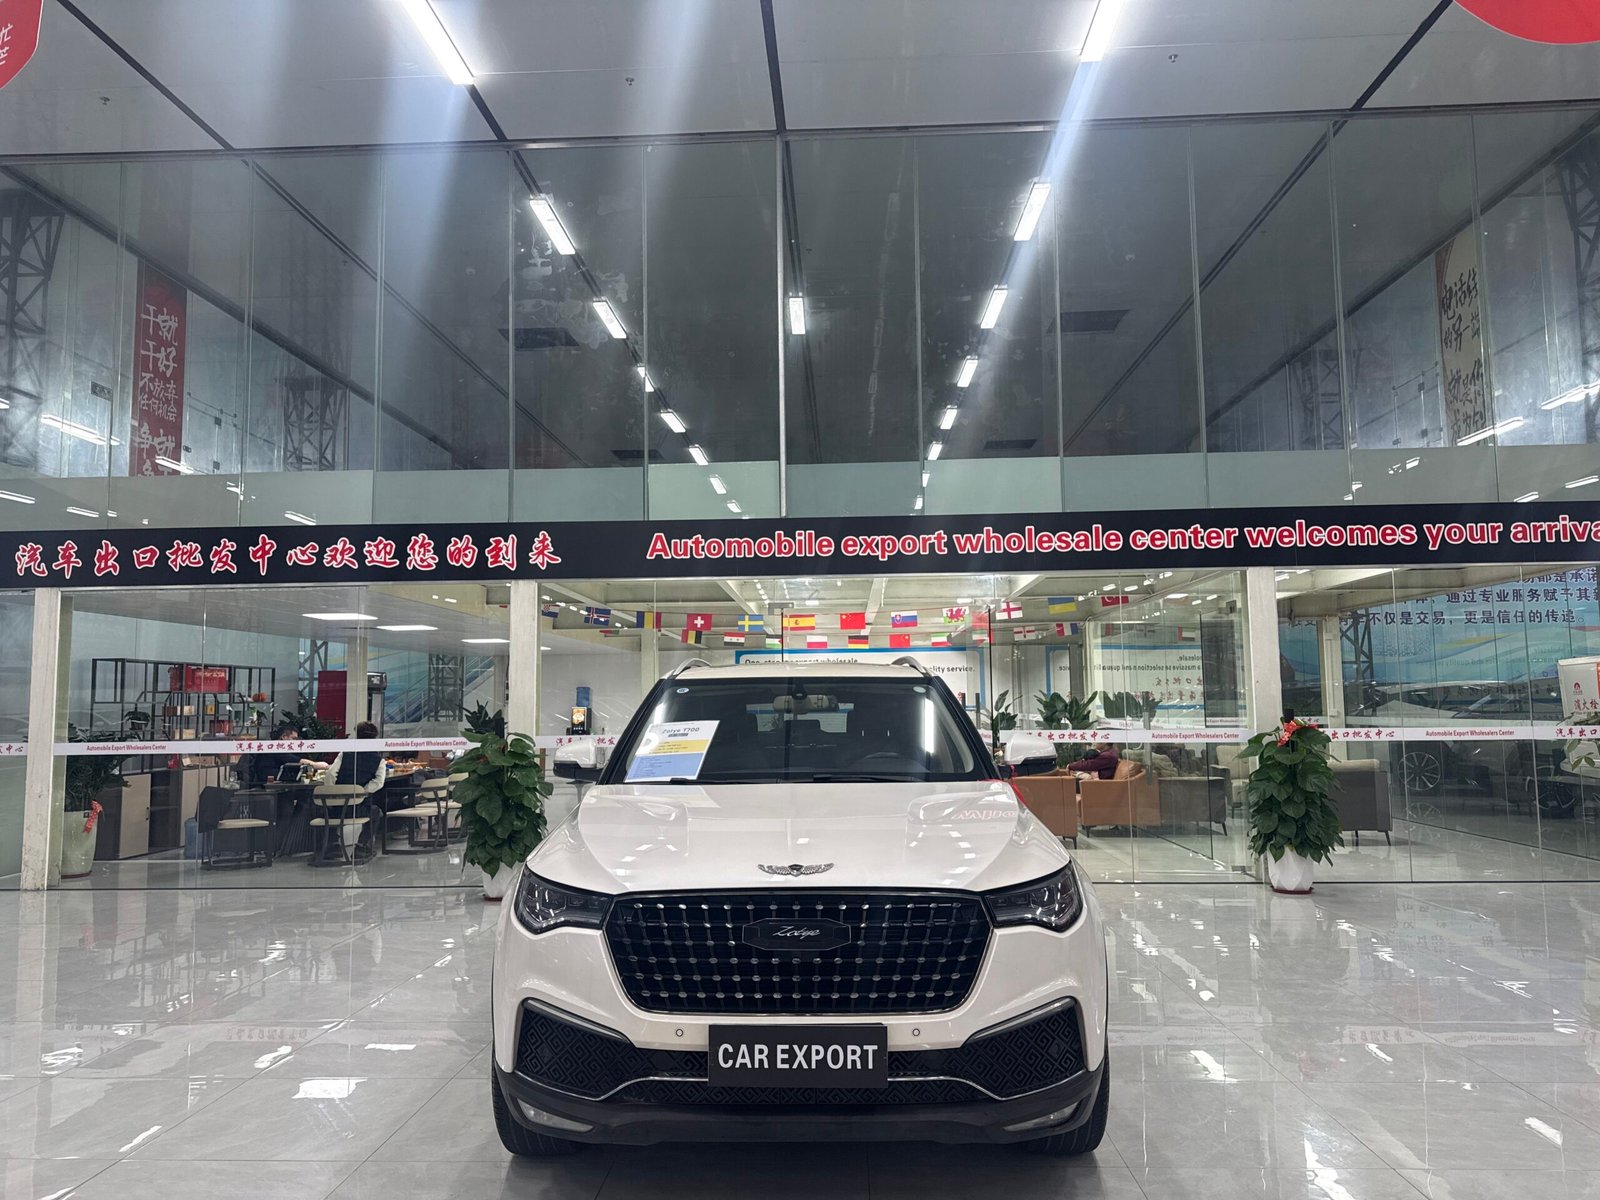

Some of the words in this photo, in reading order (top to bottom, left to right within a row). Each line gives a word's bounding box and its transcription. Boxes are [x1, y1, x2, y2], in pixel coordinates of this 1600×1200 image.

[139, 372, 179, 402] 不放弃
[138, 393, 178, 423] 任何机会
[646, 530, 835, 560] Automobile
[840, 529, 948, 561] export
[953, 524, 1123, 554] wholesale
[1129, 523, 1239, 550] center
[1244, 519, 1417, 548] welcomes
[1422, 521, 1504, 551] your
[15, 530, 562, 579] 汽车出口批发中心欢迎您的到来
[1026, 731, 1111, 741] 出口批发中心
[1179, 732, 1195, 740] Export
[1323, 728, 1396, 740] 出口批发中心
[1453, 729, 1470, 738] Export
[1469, 729, 1499, 737] Wholesalers
[235, 741, 316, 752] 汽车出口批发中心
[772, 925, 821, 940] Zotye
[717, 1042, 770, 1070] CAR
[775, 1043, 879, 1070] EXPORT
